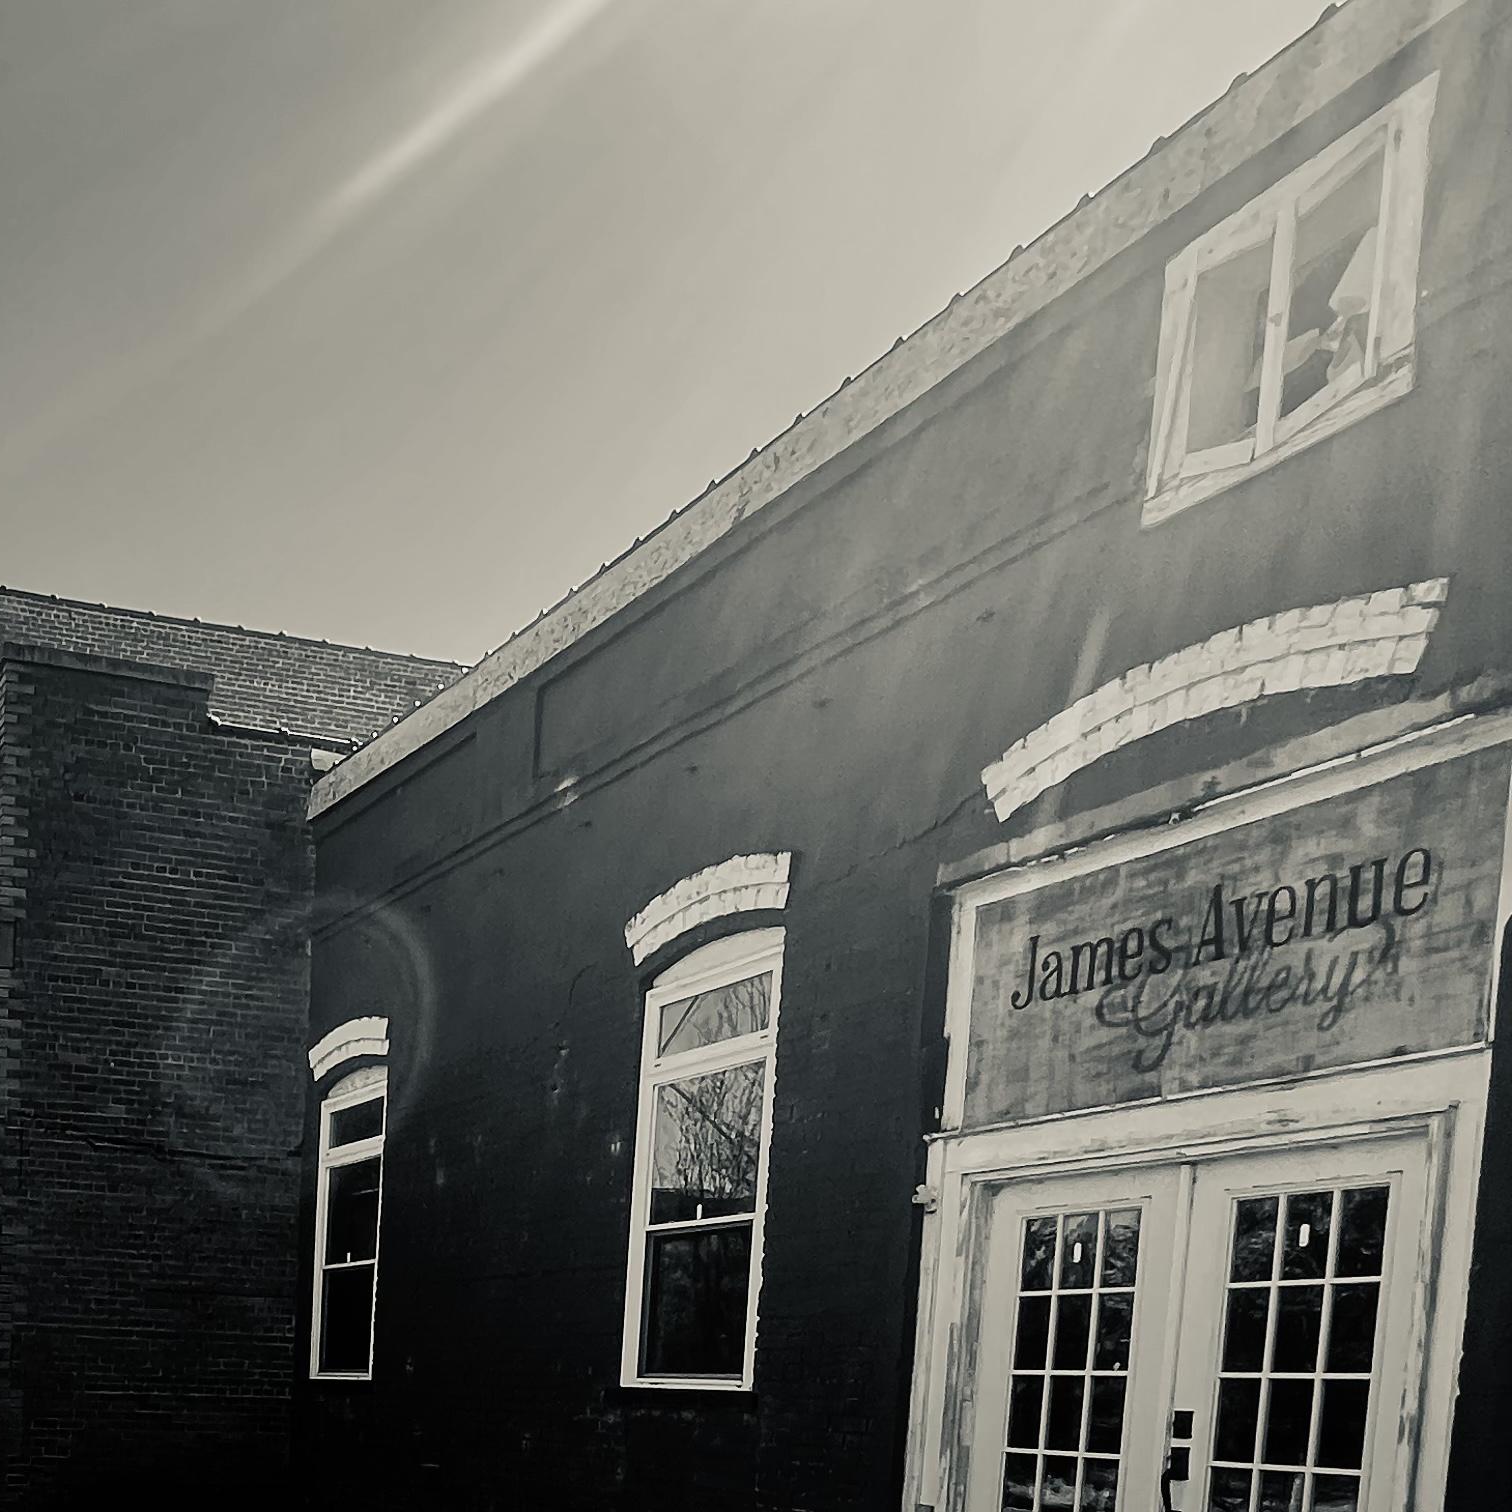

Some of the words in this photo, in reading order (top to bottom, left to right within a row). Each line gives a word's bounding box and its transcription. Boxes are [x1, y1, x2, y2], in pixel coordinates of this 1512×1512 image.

[1011, 917, 1174, 1010] James
[1191, 847, 1433, 966] Avenue
[1095, 925, 1397, 1073] Gallery
